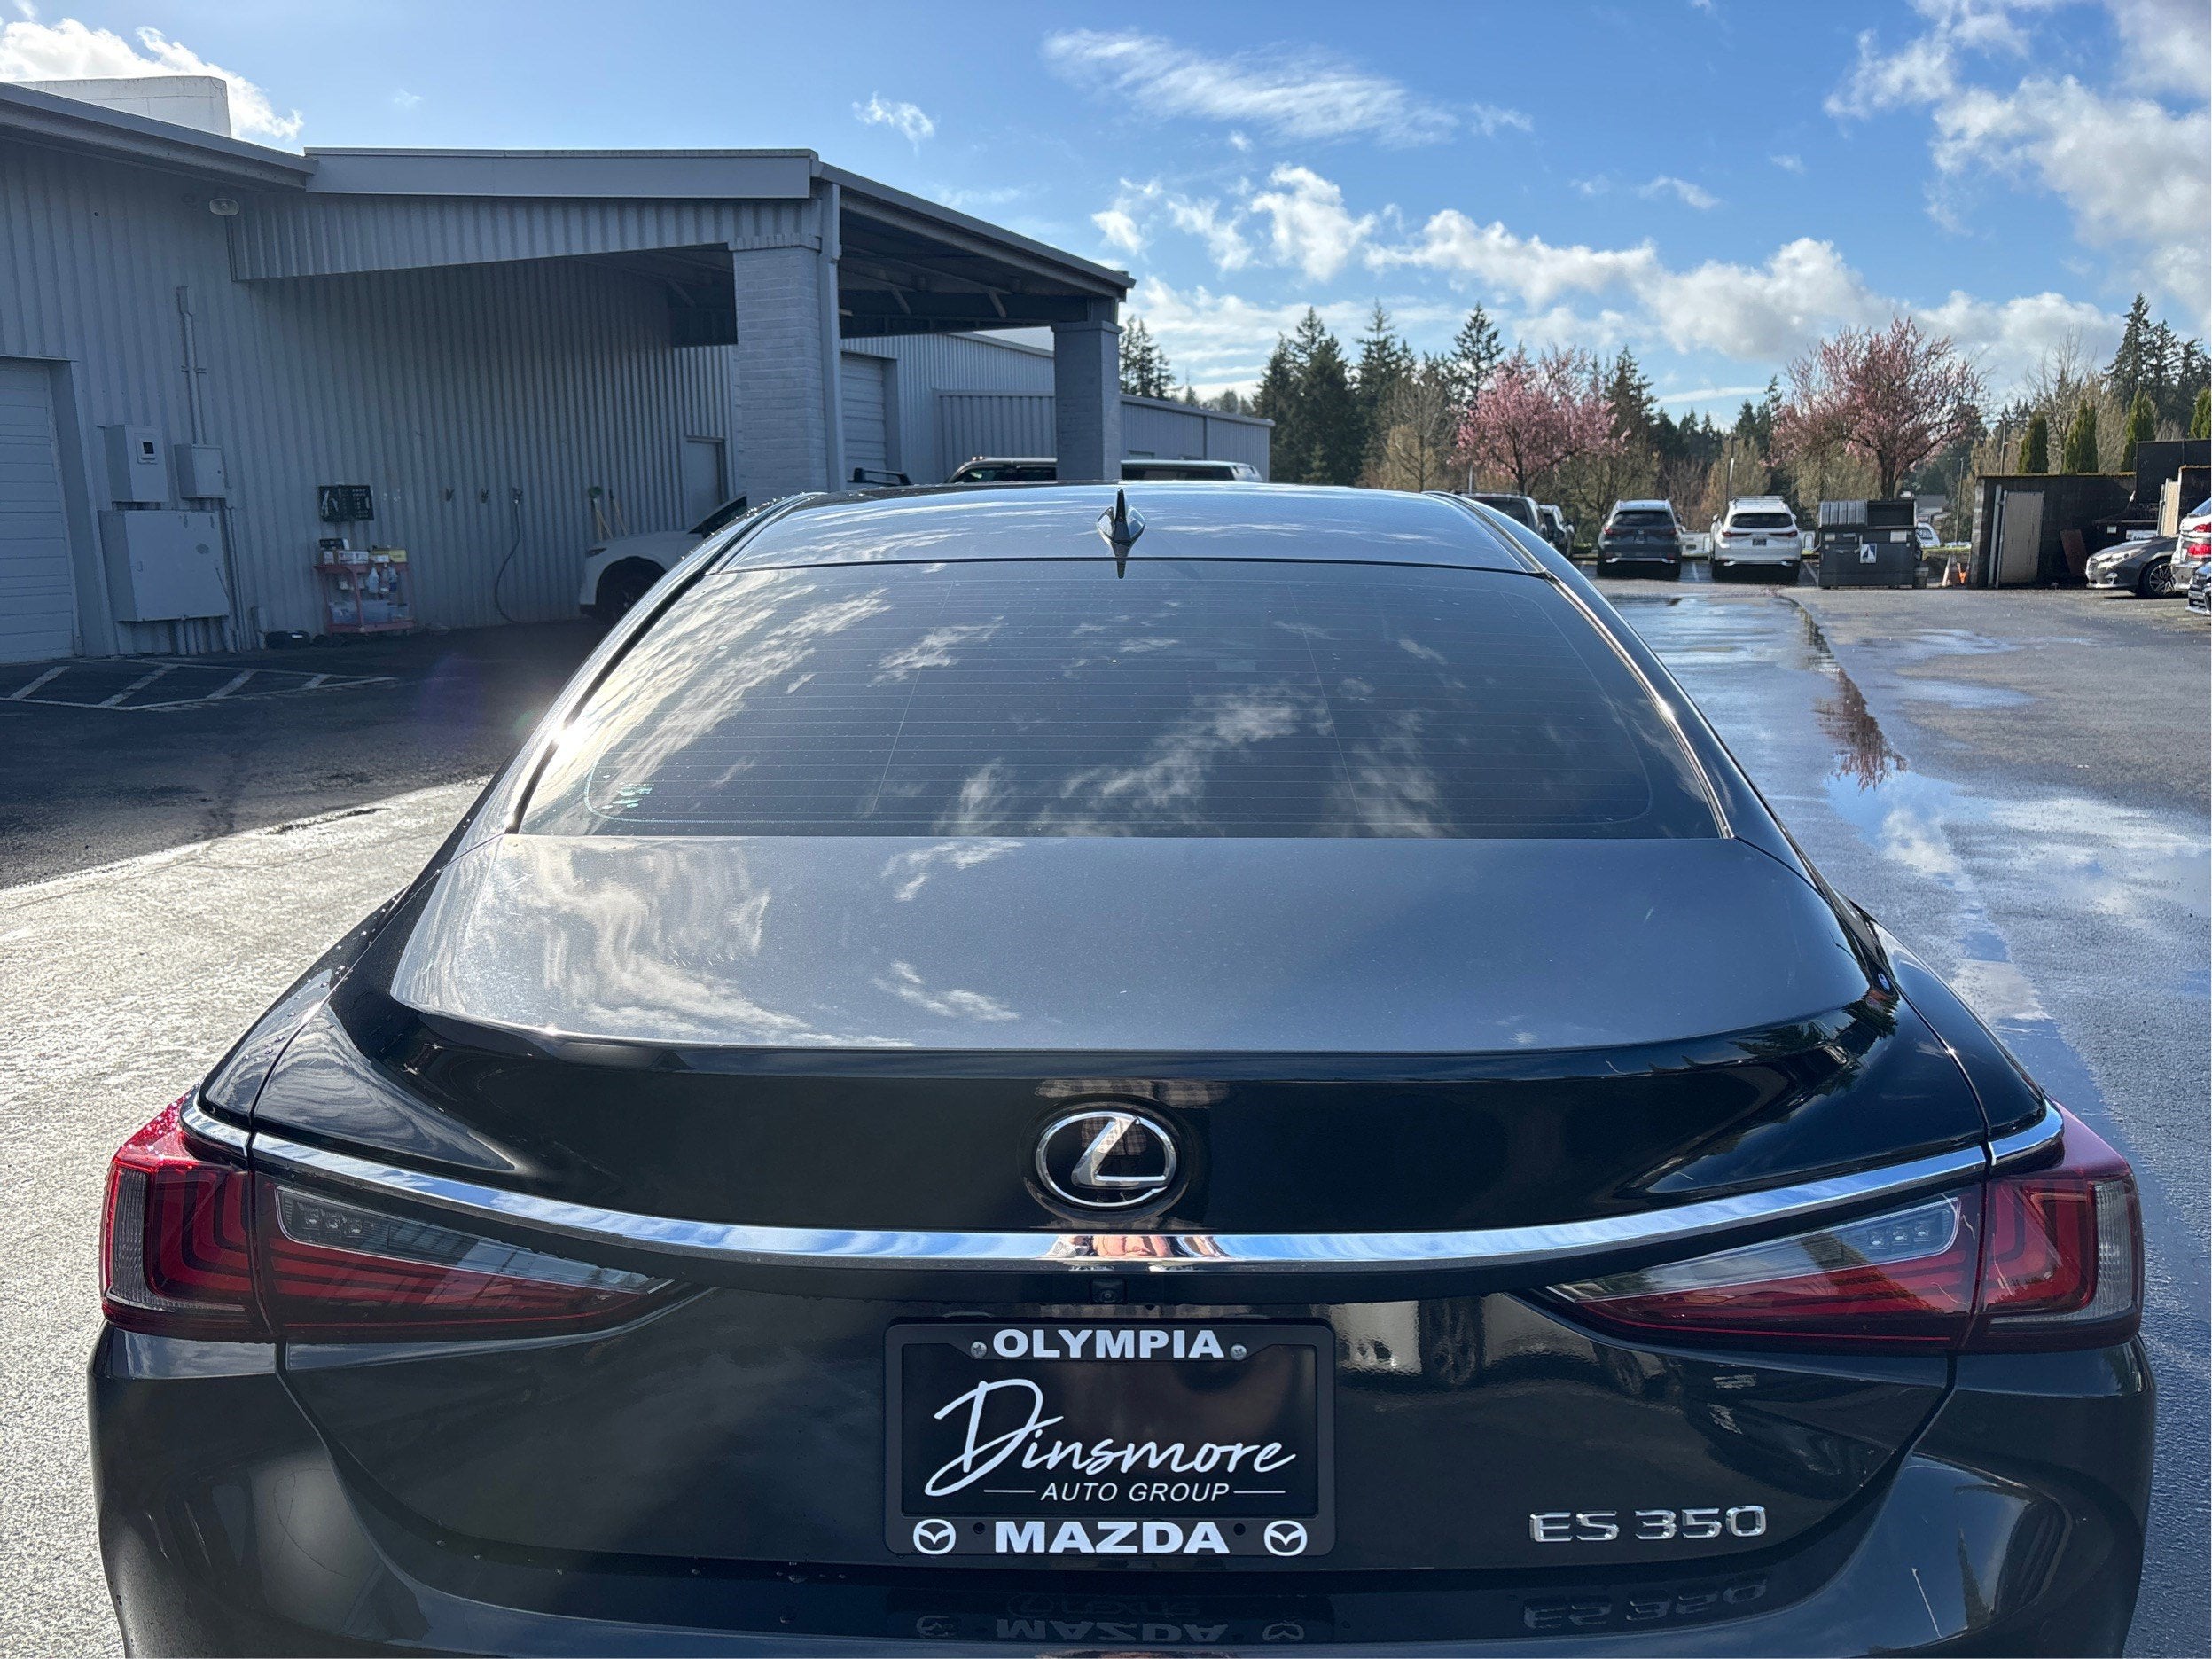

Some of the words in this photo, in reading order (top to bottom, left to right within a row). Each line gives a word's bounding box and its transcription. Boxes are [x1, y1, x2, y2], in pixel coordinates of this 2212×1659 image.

[992, 1329, 1225, 1358] OLYMPIA
[924, 1378, 1297, 1496] Dinsmore
[1040, 1483, 1118, 1502] AUTO
[1129, 1483, 1231, 1502] GROUP
[995, 1520, 1231, 1554] MAZDA
[1529, 1511, 1620, 1542] ES
[1635, 1505, 1767, 1539] 350
